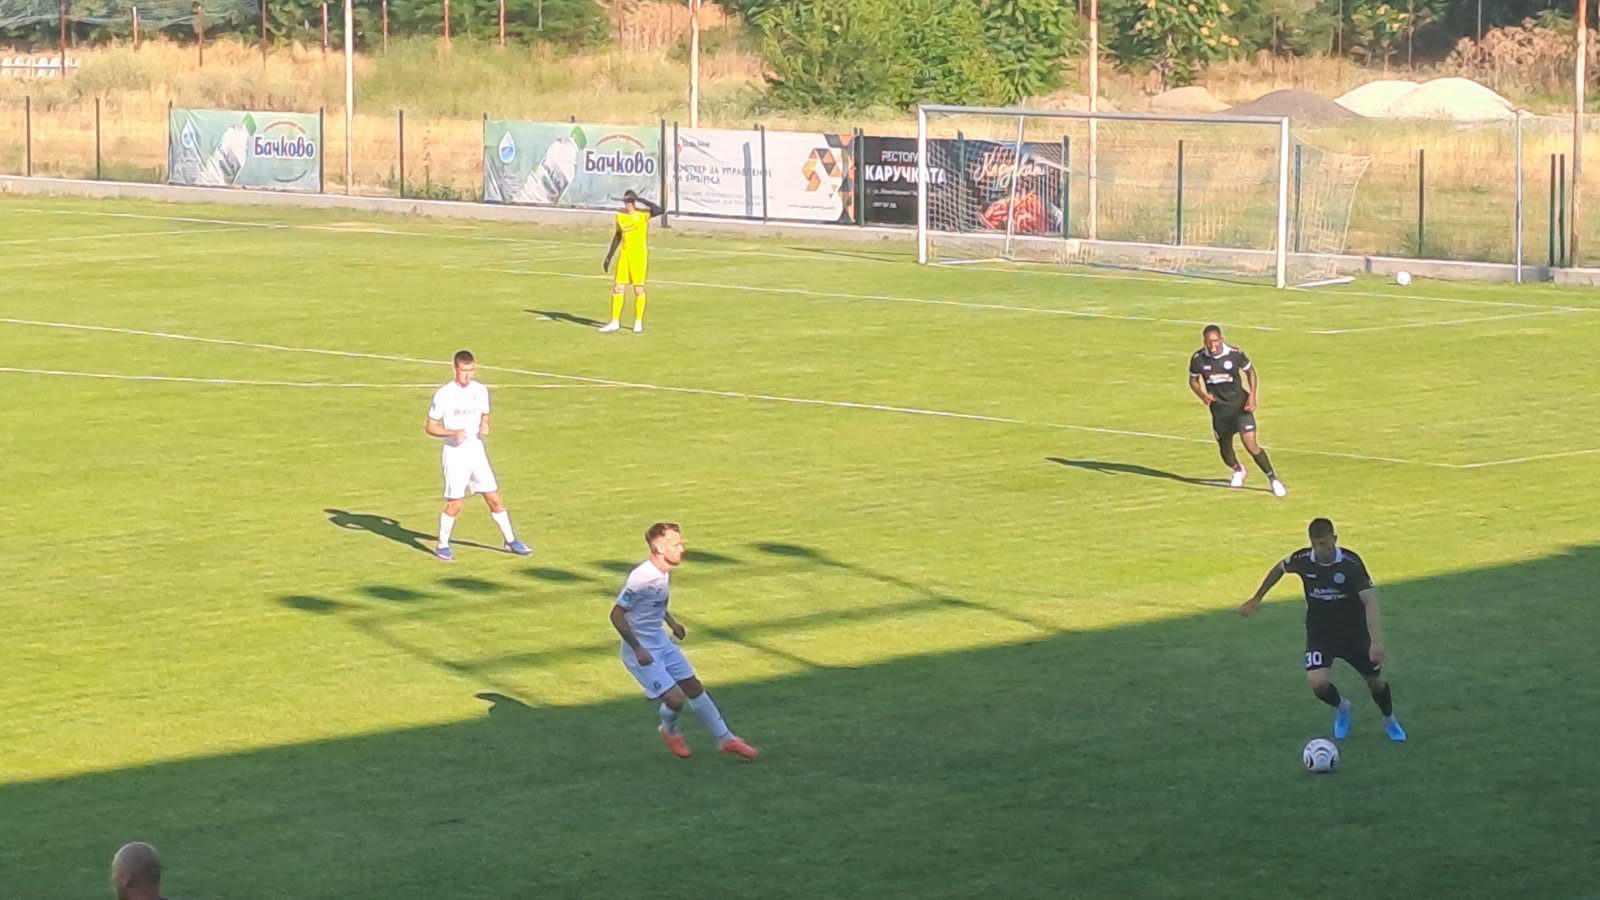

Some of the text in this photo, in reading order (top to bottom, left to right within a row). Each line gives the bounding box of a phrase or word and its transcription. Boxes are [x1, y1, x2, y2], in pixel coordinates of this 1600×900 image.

[255, 136, 314, 157] Бачково
[585, 150, 655, 174] Бачково
[1306, 651, 1322, 668] 30
